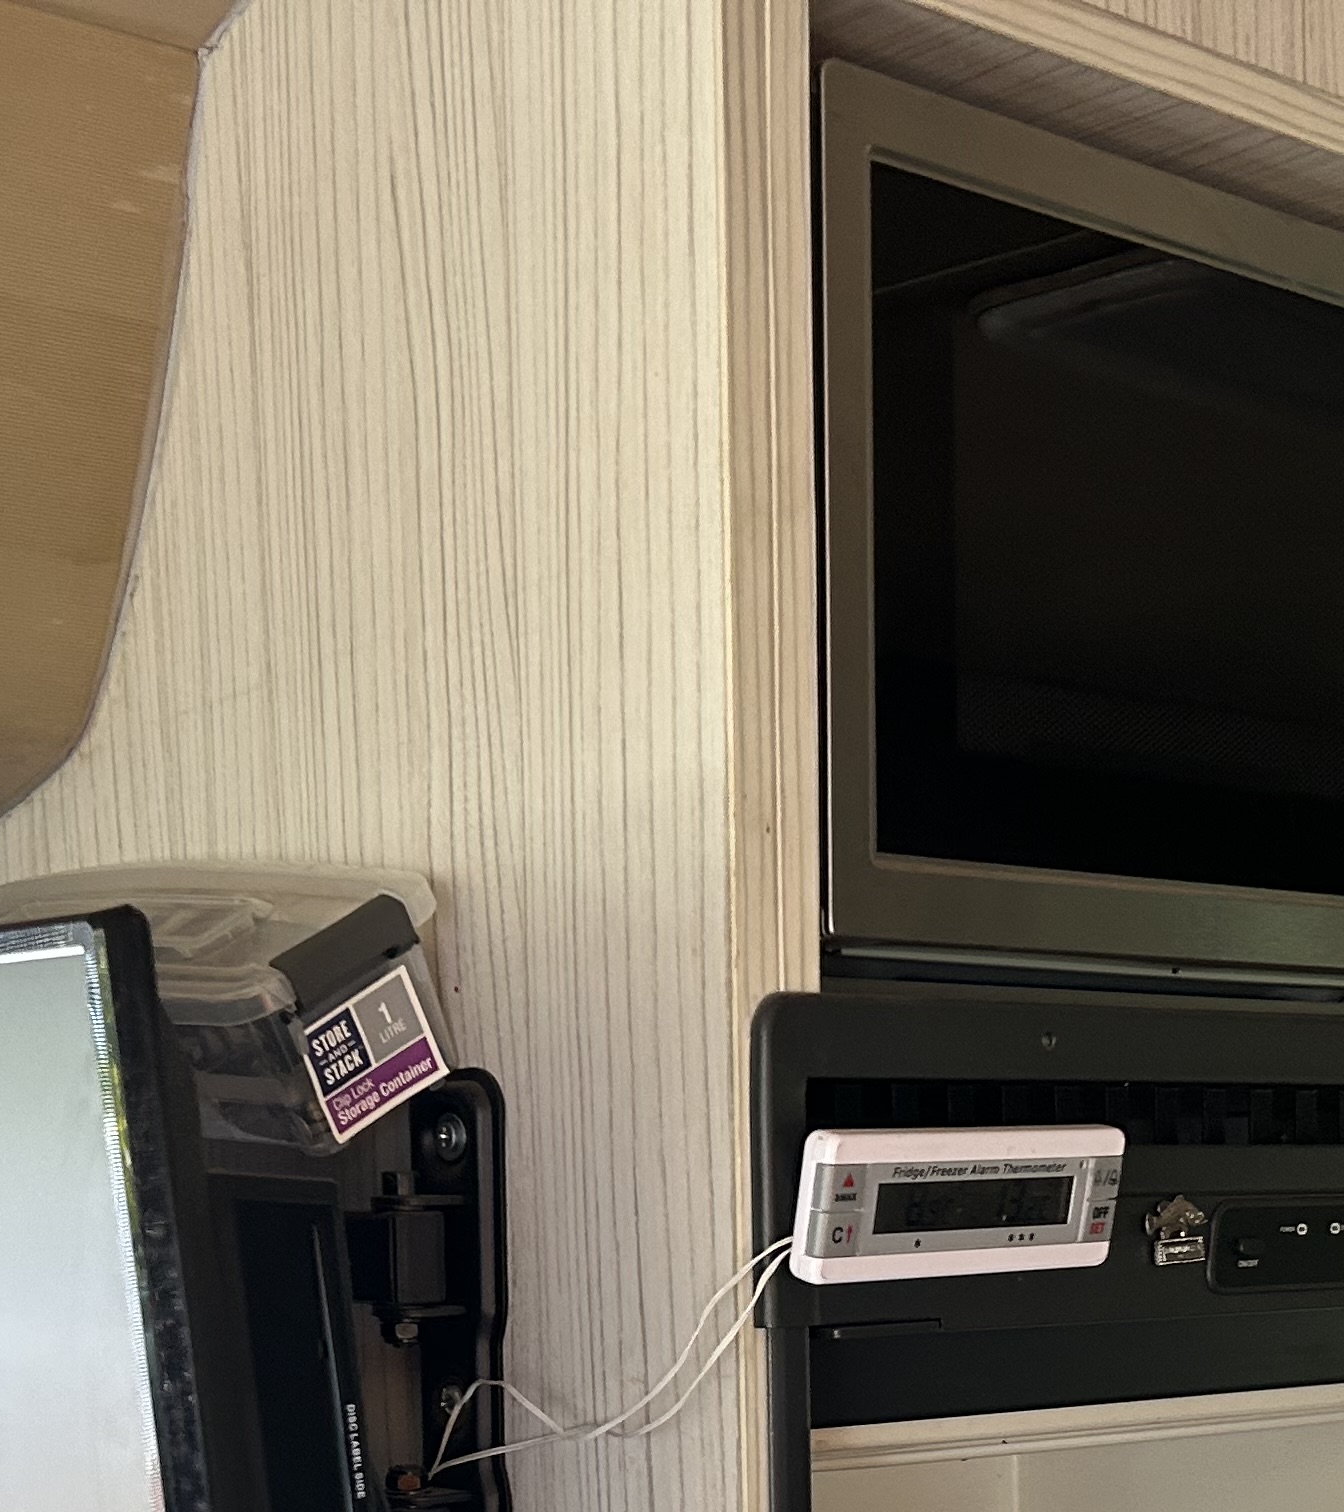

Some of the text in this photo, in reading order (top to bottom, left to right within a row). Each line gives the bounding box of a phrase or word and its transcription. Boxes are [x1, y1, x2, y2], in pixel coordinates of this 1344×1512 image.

[378, 1002, 393, 1024] 1
[311, 1019, 352, 1058] STORE
[378, 1020, 408, 1044] LITRE
[323, 1049, 364, 1086] STACK
[327, 1044, 349, 1062] AND
[331, 1077, 376, 1112] Clip Lock
[337, 1055, 434, 1126] Storage Container
[969, 1163, 1001, 1176] Alarm
[1002, 1161, 1068, 1175] Thermometer
[346, 1404, 366, 1499] DISC LABEL SIDE
